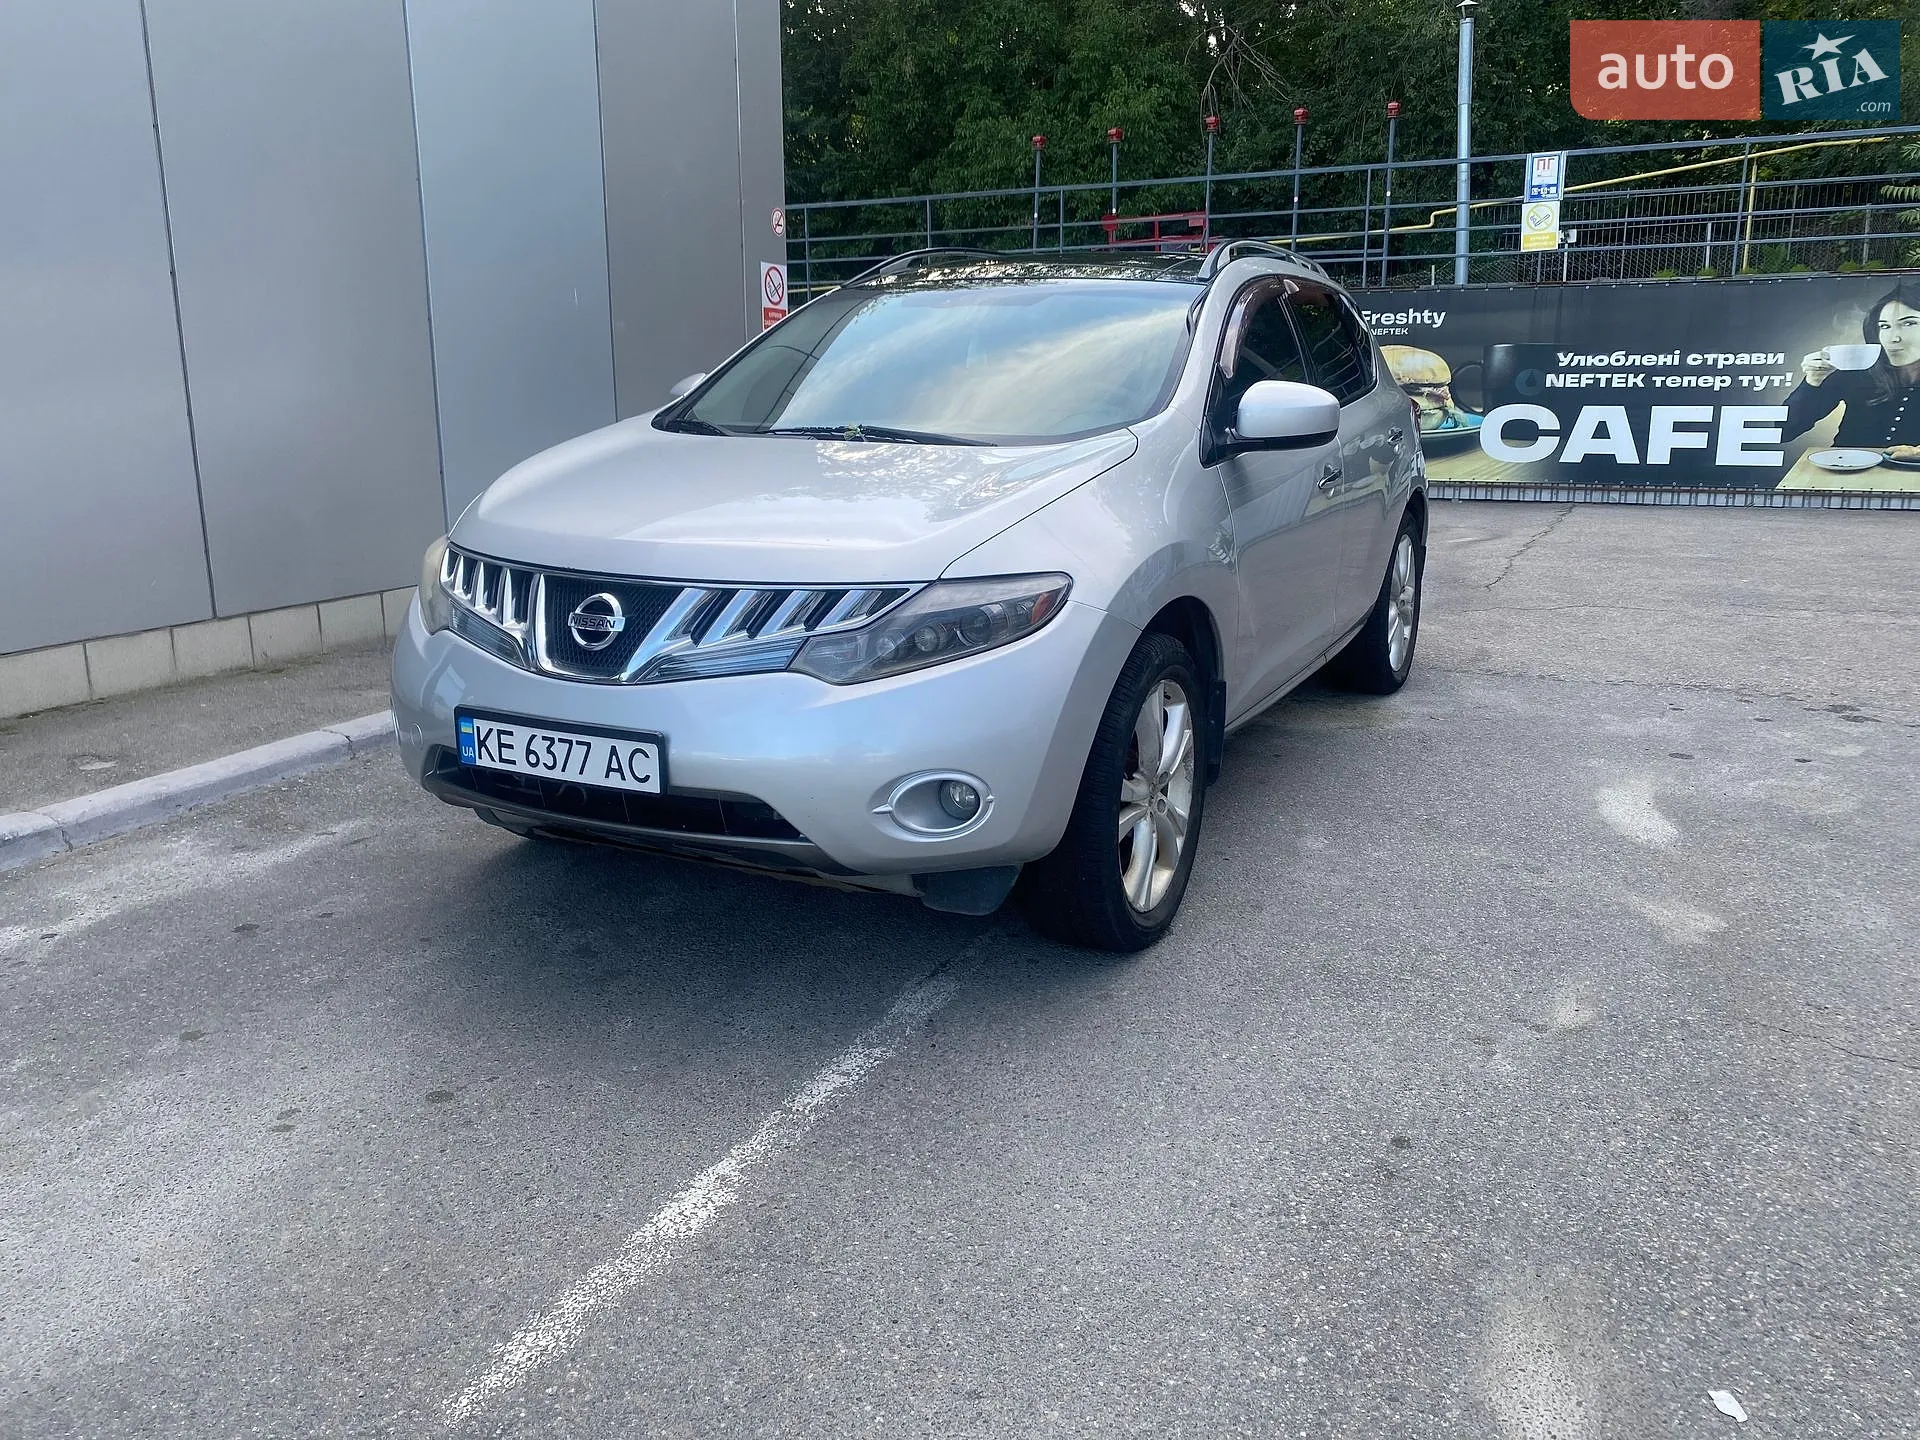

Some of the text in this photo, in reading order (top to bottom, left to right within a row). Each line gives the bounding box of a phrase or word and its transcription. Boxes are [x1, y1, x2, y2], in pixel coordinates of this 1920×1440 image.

[1536, 157, 1555, 171] ПГ
[1361, 307, 1446, 329] Freshty
[1556, 350, 1785, 369] Улюблені страви
[1545, 371, 1794, 392] NEFTEK тепер тут!
[1479, 403, 1790, 467] CAFE
[570, 614, 617, 629] NISSAN
[462, 746, 475, 759] UA
[475, 725, 651, 784] KE 6377 AC
